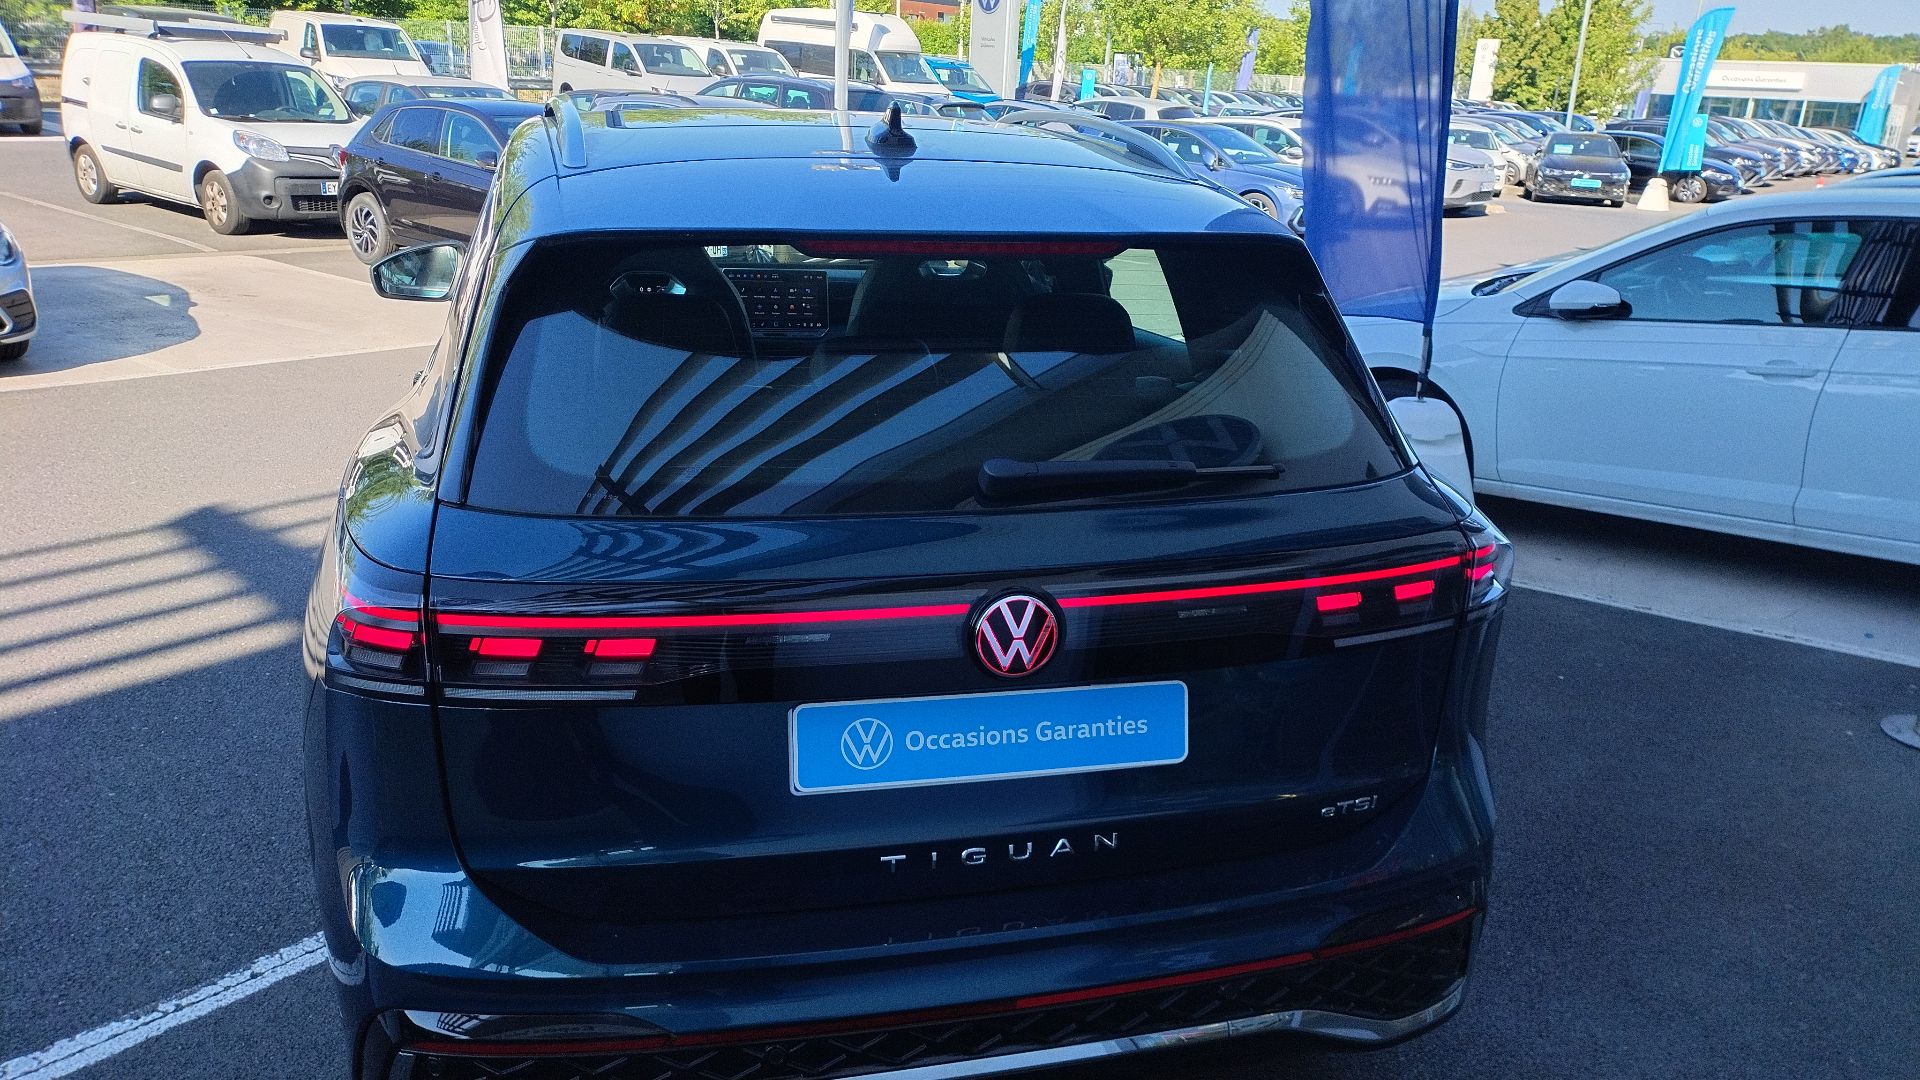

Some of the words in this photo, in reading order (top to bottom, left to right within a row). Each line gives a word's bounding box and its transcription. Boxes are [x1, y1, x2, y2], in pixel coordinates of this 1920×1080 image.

[905, 725, 1029, 751] Occasions
[1036, 715, 1148, 742] Garanties
[880, 832, 1118, 872] TIGUAN
